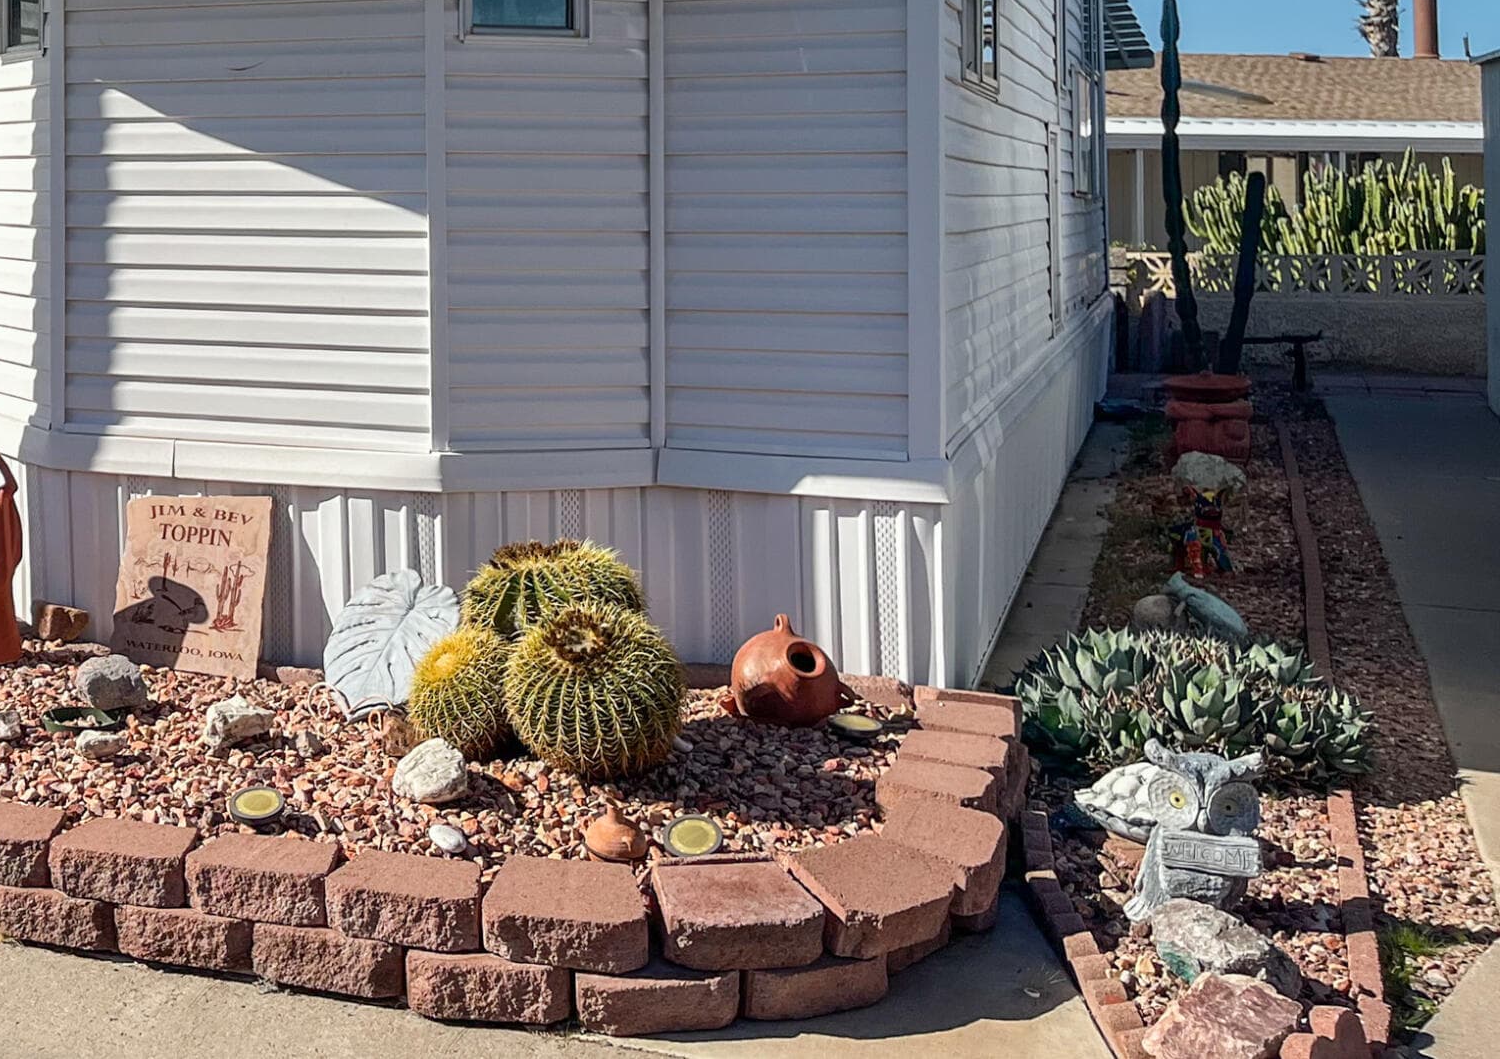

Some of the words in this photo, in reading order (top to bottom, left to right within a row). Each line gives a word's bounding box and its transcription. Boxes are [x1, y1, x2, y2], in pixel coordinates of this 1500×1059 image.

[149, 505, 186, 520] JIM
[192, 507, 206, 518] &
[214, 509, 254, 525] BEV
[159, 523, 233, 548] TOPPIN
[126, 640, 204, 658] WATERLOO,
[208, 650, 244, 662] IOWA
